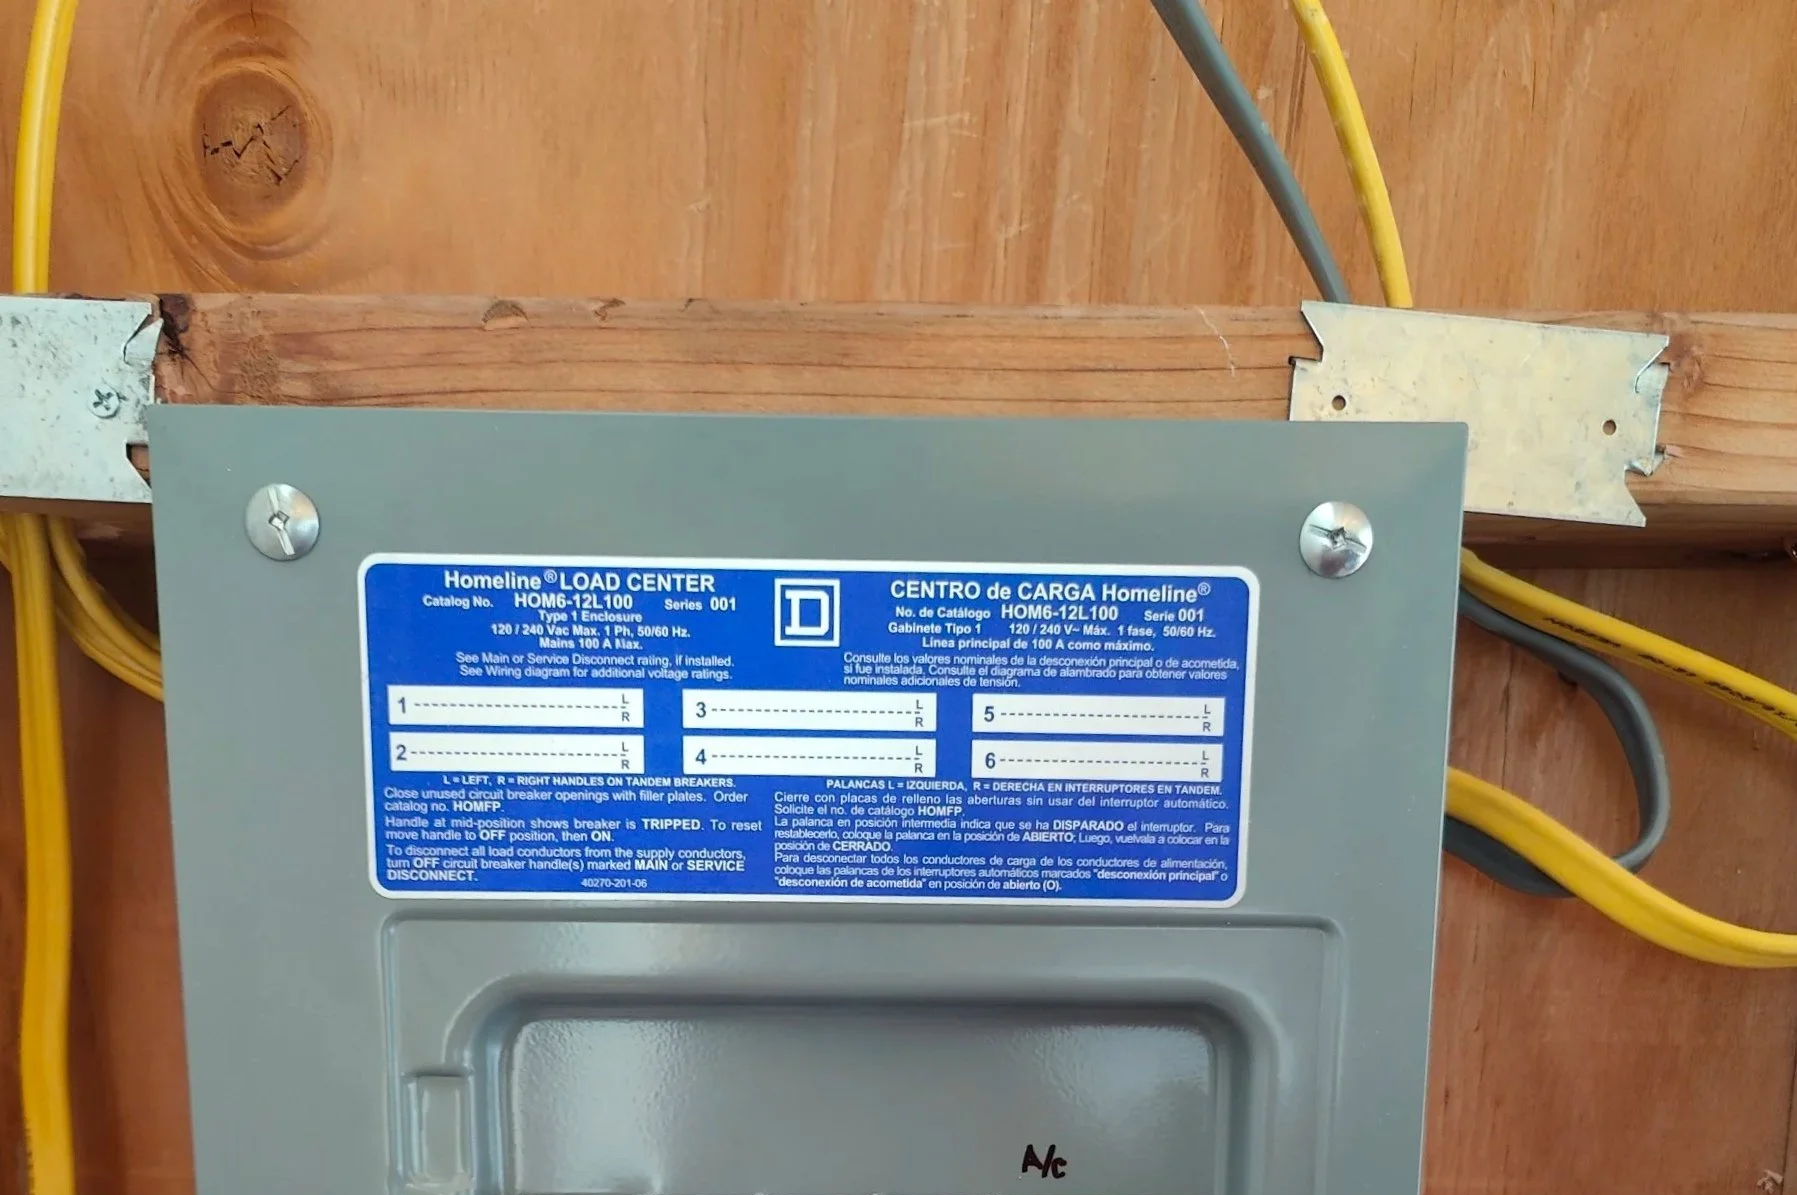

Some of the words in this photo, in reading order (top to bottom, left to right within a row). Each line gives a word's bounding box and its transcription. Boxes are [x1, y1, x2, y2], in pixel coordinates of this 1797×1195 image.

[559, 572, 620, 591] LOAD
[626, 573, 715, 593] CENTER
[890, 580, 980, 600] CENTRO
[986, 580, 1011, 600] de
[1017, 582, 1095, 601] CARGA
[422, 596, 470, 610] Catalog
[472, 596, 493, 608] No.
[514, 594, 632, 610] HOM6-12L100
[664, 599, 702, 611] Series
[710, 596, 735, 611] 001
[538, 609, 568, 624] Type
[570, 610, 577, 622] 1
[580, 610, 642, 623] Enclosure
[895, 605, 915, 618] No.
[918, 605, 934, 618] de
[936, 606, 990, 621] Catálogo
[1001, 604, 1118, 621] HOM6-12L100
[1144, 609, 1175, 622] Serie
[1178, 606, 1204, 622] 001
[491, 623, 512, 635] 120
[522, 623, 544, 636] 240
[545, 624, 569, 636] Vac
[572, 624, 600, 636] Max.
[604, 624, 610, 636] 1
[614, 625, 634, 638] Ph,
[636, 625, 668, 637] 50/60
[671, 625, 690, 637] Hz.
[888, 620, 942, 633] Gabinete
[944, 621, 971, 636] Tipo
[974, 621, 980, 634] 1
[1009, 622, 1030, 635] 120
[1039, 623, 1061, 635] 240
[1082, 623, 1110, 636] Máx.
[1117, 624, 1124, 636] 1
[1126, 624, 1156, 639] fase,
[1162, 625, 1195, 638] 50/60
[1197, 625, 1216, 638] Hz.
[539, 636, 575, 649] Mains
[578, 637, 599, 649] 100
[602, 637, 612, 649] A
[922, 635, 955, 648] Línea
[958, 635, 1010, 651] principal
[1012, 636, 1028, 649] de
[1031, 636, 1052, 649] 100
[1054, 637, 1064, 649] A
[1067, 640, 1102, 650] como
[1103, 637, 1154, 650] máximo.
[456, 652, 479, 663] See
[481, 652, 510, 664] Main
[511, 655, 524, 664] or
[526, 653, 569, 665] Service
[571, 653, 634, 666] Disconnect
[636, 654, 672, 669] rating,
[674, 655, 683, 666] if
[684, 655, 734, 667] installed.
[459, 665, 483, 676] See
[484, 665, 522, 679] Wiring
[524, 665, 570, 680] diagram
[572, 666, 588, 677] for
[590, 666, 645, 678] additional
[647, 667, 688, 681] voltage
[690, 668, 732, 682] ratings.
[397, 696, 406, 714] 1
[695, 701, 707, 719] 3
[983, 705, 995, 723] 5
[396, 743, 407, 761] 2
[695, 748, 707, 765] 4
[984, 752, 996, 770] 6
[443, 775, 450, 786] L
[462, 775, 491, 787] LEFT,
[496, 775, 505, 786] R
[516, 776, 550, 786] RIGHT
[552, 776, 604, 787] HANDLES
[606, 776, 623, 787] ON
[625, 776, 671, 787] TANDEM
[673, 777, 736, 787] BREAKERS.
[826, 779, 885, 790] PALANCAS
[888, 780, 894, 790] L
[906, 780, 967, 793] IZQUIERDA,
[972, 781, 981, 792] R
[992, 781, 1045, 793] DERECHA
[1047, 782, 1062, 793] EN
[1064, 782, 1155, 794] INTERRUPTORES
[1157, 784, 1172, 795] EN
[1174, 784, 1222, 795] TANDEM.
[383, 787, 419, 799] Close
[421, 787, 466, 800] unused
[468, 788, 504, 800] circuit
[506, 788, 552, 801] breaker
[554, 789, 609, 804] openings
[611, 789, 636, 802] with
[638, 790, 664, 802] filler
[667, 790, 706, 805] plates.
[713, 791, 748, 803] Order
[384, 801, 428, 814] catalog
[430, 803, 448, 812] no.
[452, 801, 504, 812] HOMFP.
[774, 803, 814, 815] Solicite
[817, 804, 827, 815] el
[850, 804, 864, 816] de
[867, 804, 914, 819] catálogo
[385, 816, 428, 828] Handle
[434, 816, 446, 828] at
[450, 817, 525, 831] mid-position
[530, 817, 569, 829] shows
[573, 818, 621, 829] breaker
[625, 818, 636, 829] is
[641, 818, 704, 830] TRIPPED.
[709, 819, 726, 830] To
[731, 819, 762, 830] reset
[385, 831, 418, 840] move
[421, 829, 462, 841] handle
[464, 830, 476, 841] to
[478, 830, 506, 841] OFF
[508, 830, 558, 844] position,
[561, 831, 588, 842] then
[590, 831, 614, 842] ON.
[580, 877, 647, 888] 40270-201-06
